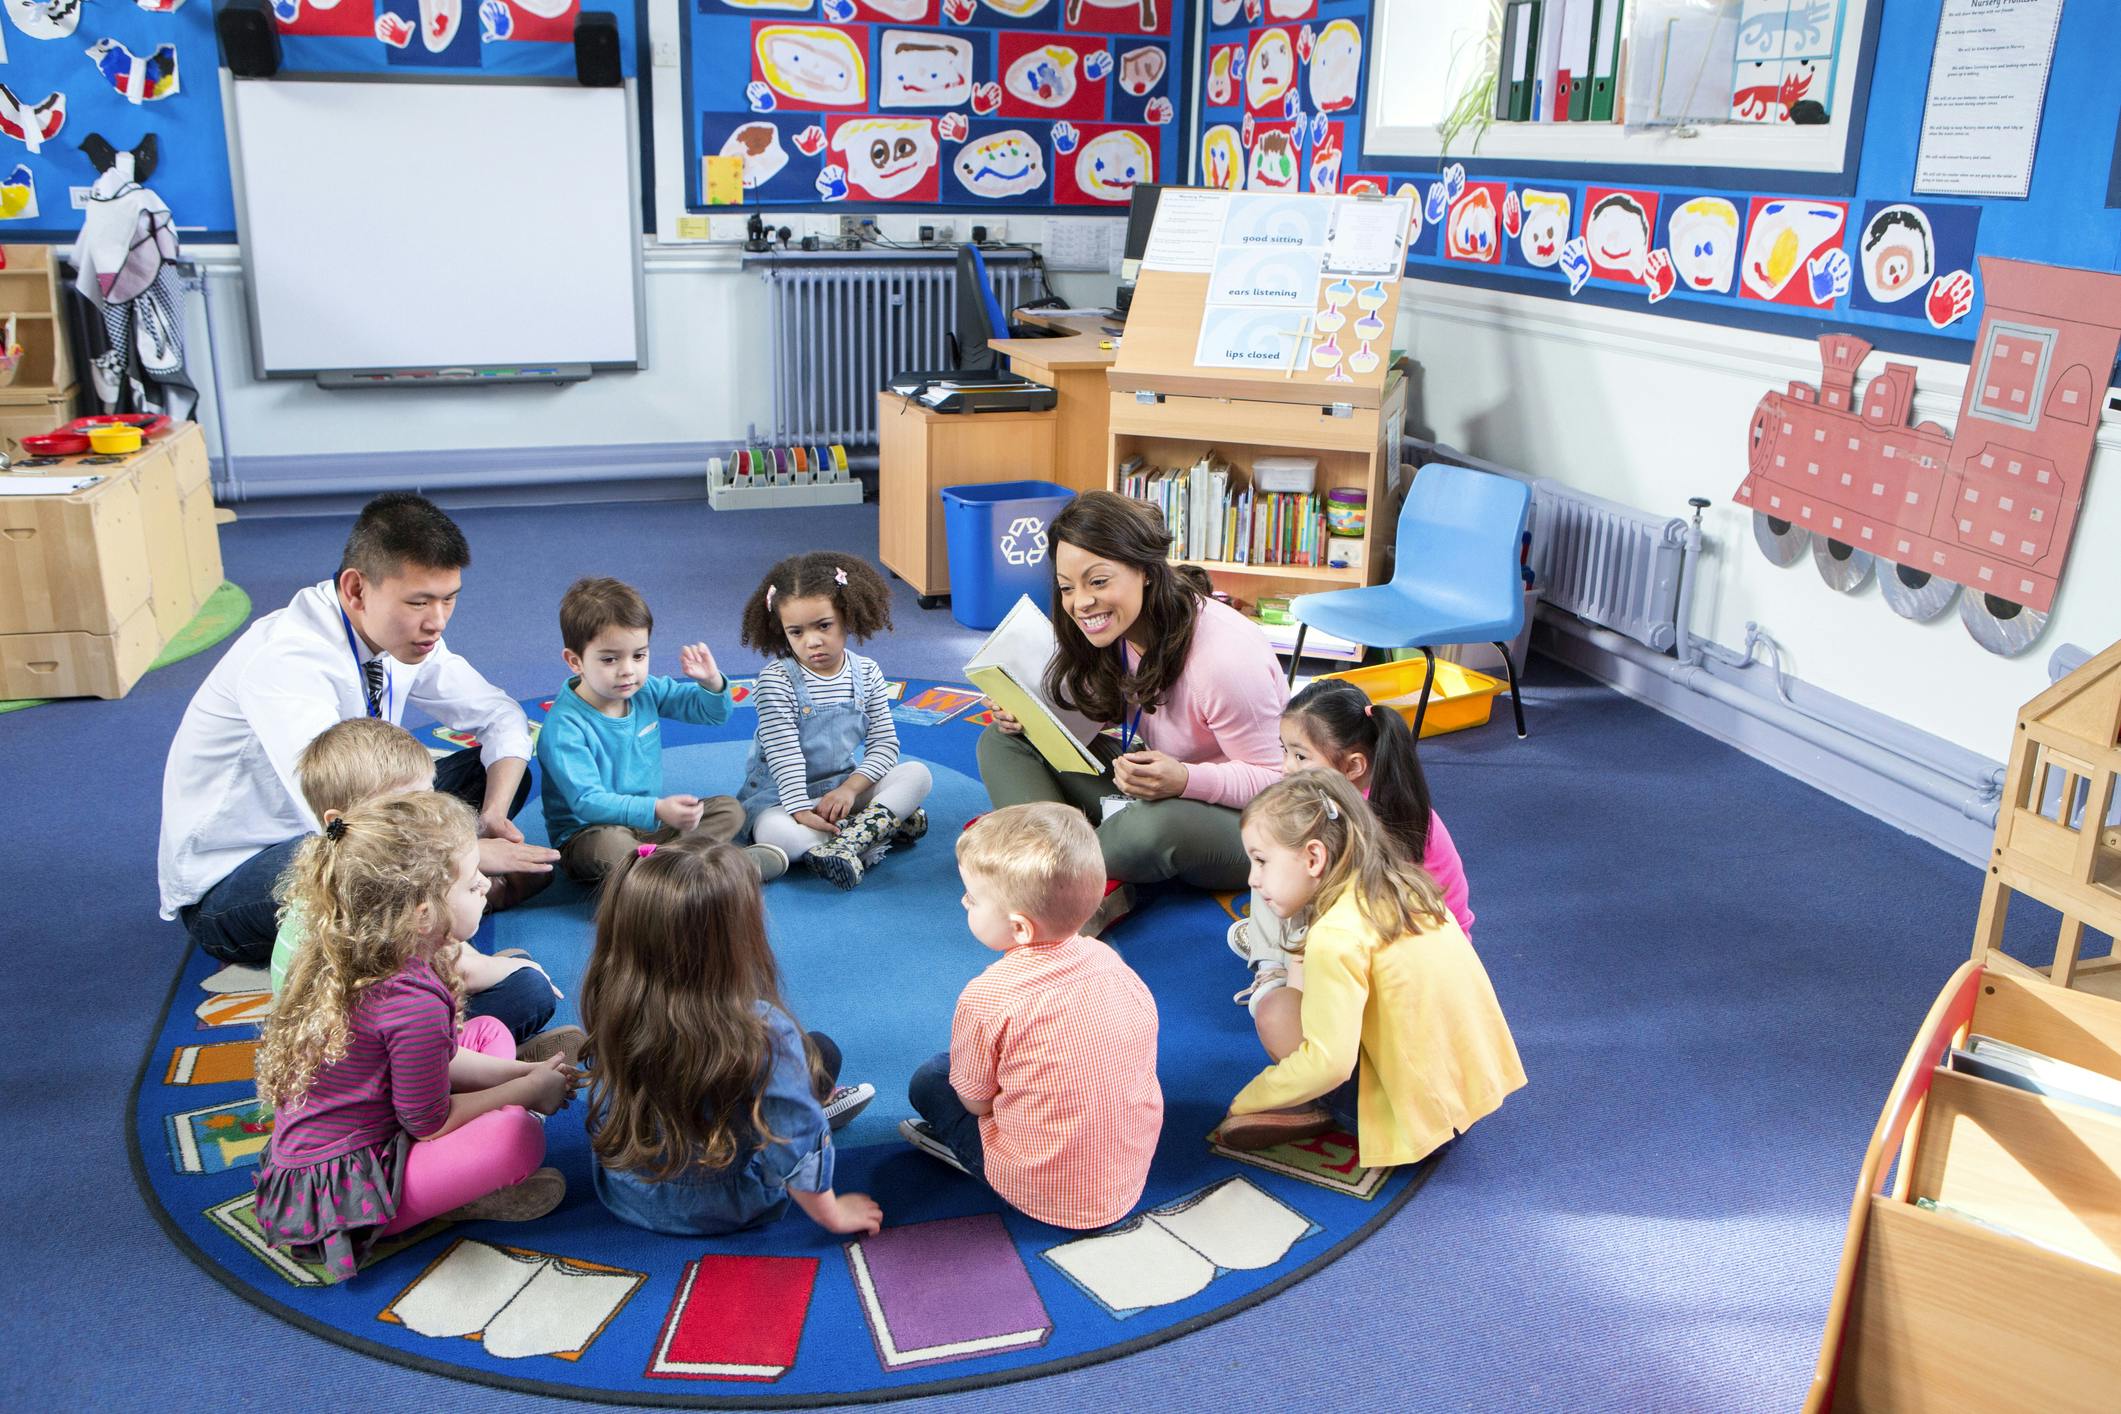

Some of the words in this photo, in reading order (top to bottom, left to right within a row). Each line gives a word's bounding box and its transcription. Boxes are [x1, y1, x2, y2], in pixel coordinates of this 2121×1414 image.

[1243, 235, 1268, 244] good
[1271, 235, 1303, 246] sitting
[1253, 288, 1297, 299] listening
[1225, 350, 1244, 360] lips
[1247, 351, 1280, 360] closed
